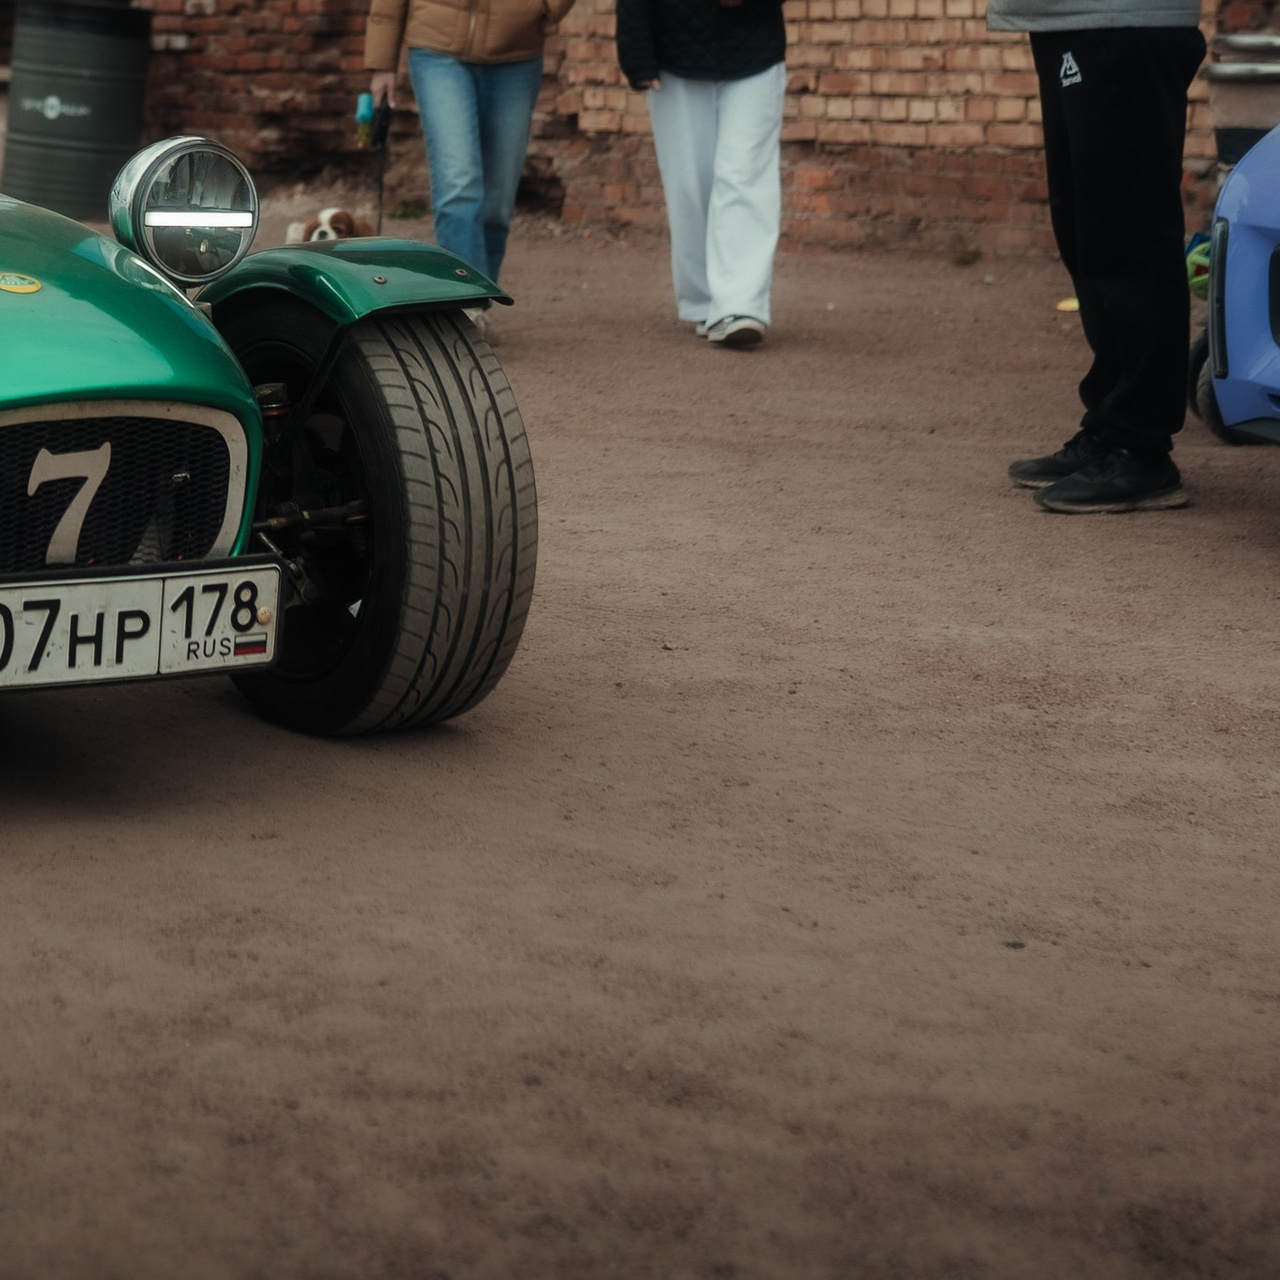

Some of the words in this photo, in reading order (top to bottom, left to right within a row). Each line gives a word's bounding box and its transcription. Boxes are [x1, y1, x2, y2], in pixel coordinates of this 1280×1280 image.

[27, 441, 111, 565] 7
[170, 581, 258, 639] 178
[187, 638, 232, 661] RUS
